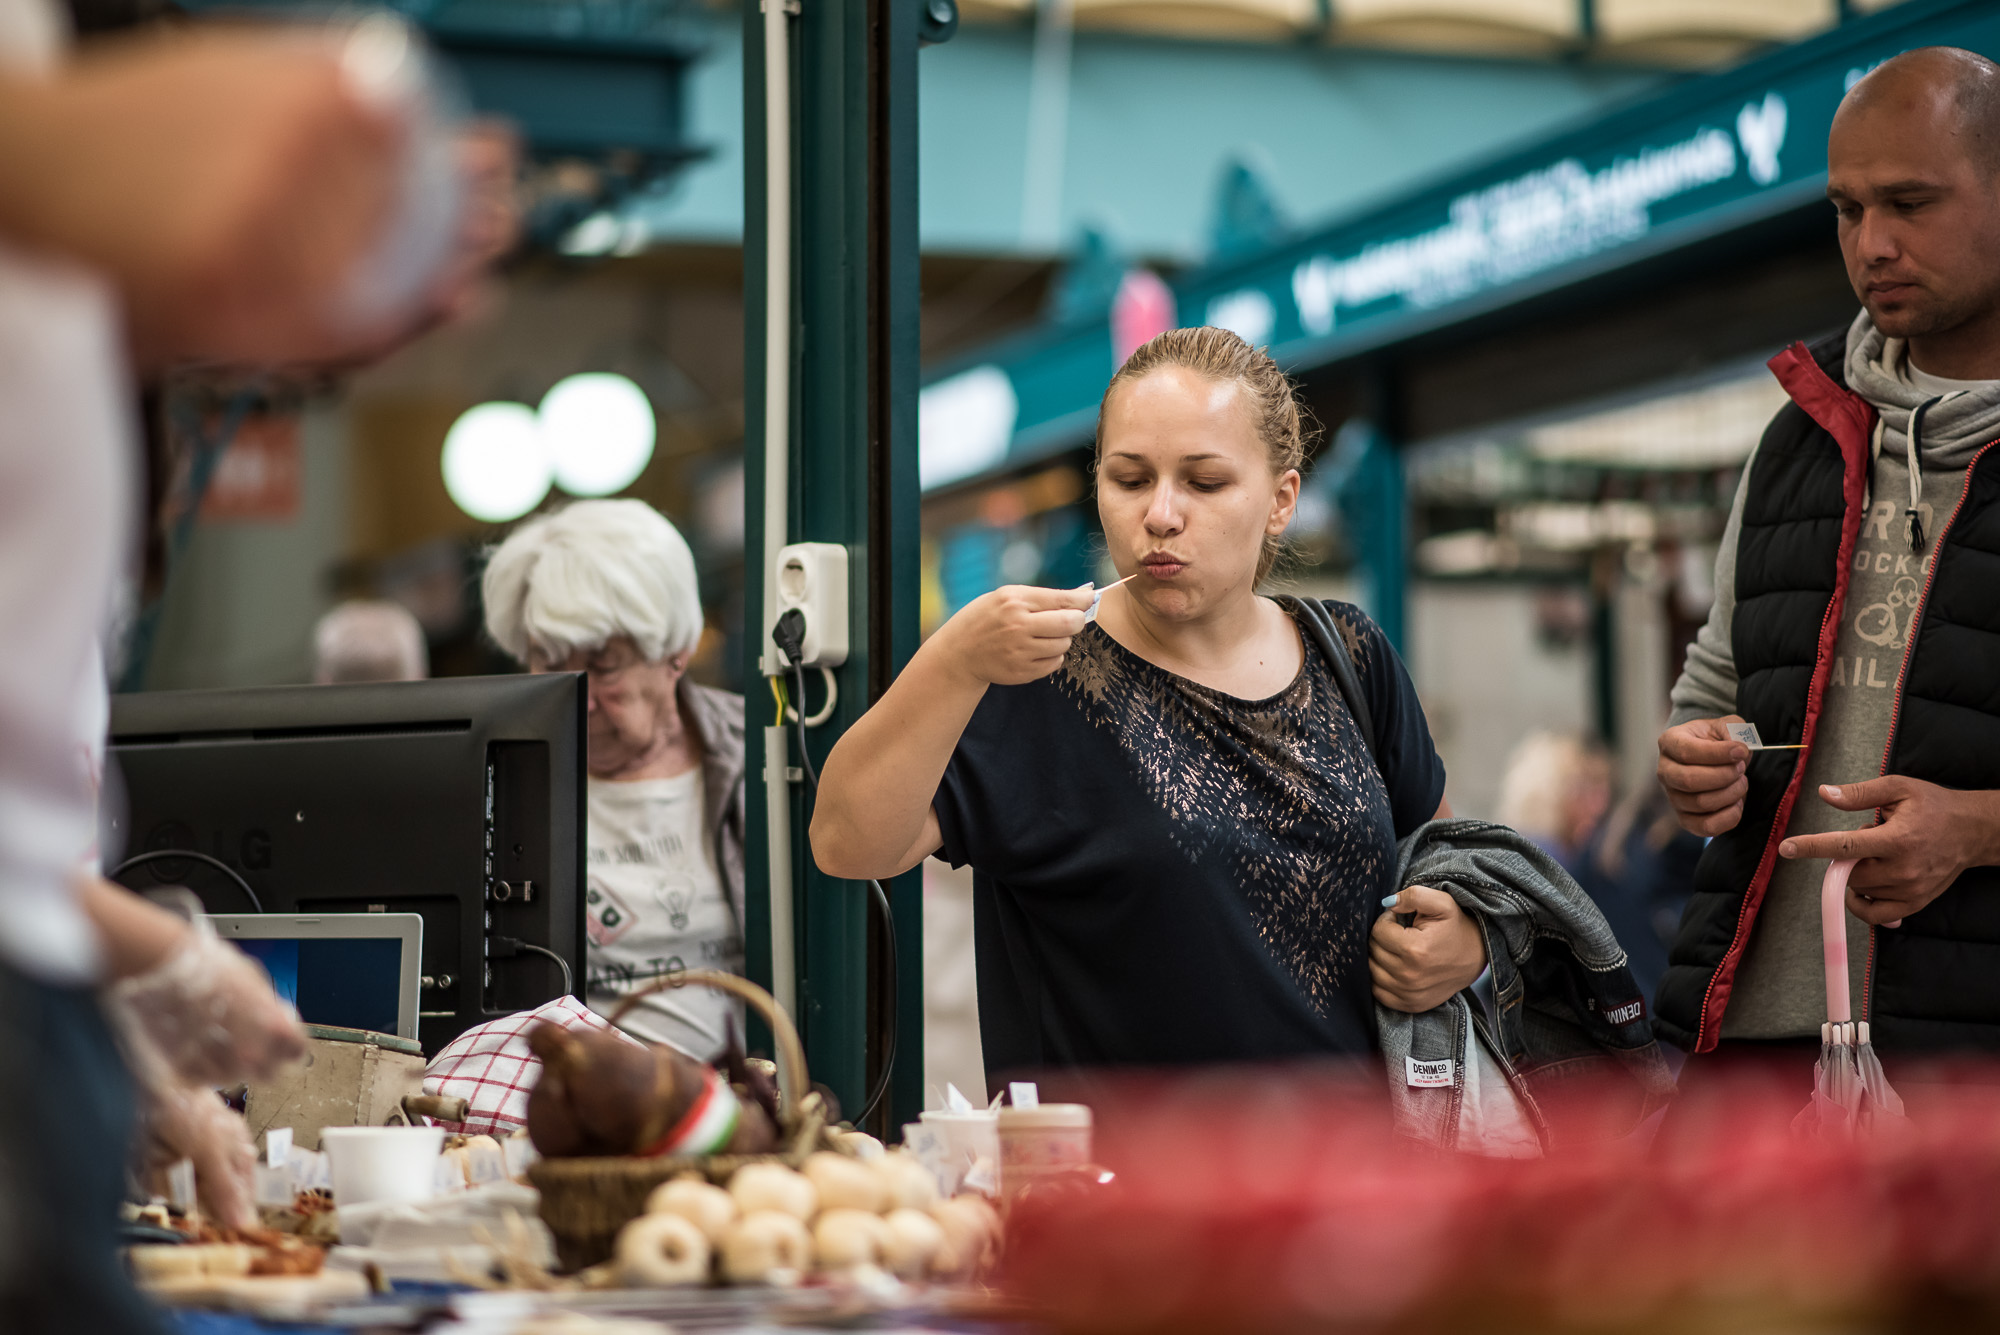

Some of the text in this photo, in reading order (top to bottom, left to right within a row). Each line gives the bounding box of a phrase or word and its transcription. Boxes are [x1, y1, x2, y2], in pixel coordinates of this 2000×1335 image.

[1830, 657, 1902, 689] AIL
[213, 828, 271, 871] LG
[1607, 1001, 1641, 1024] DENIM
